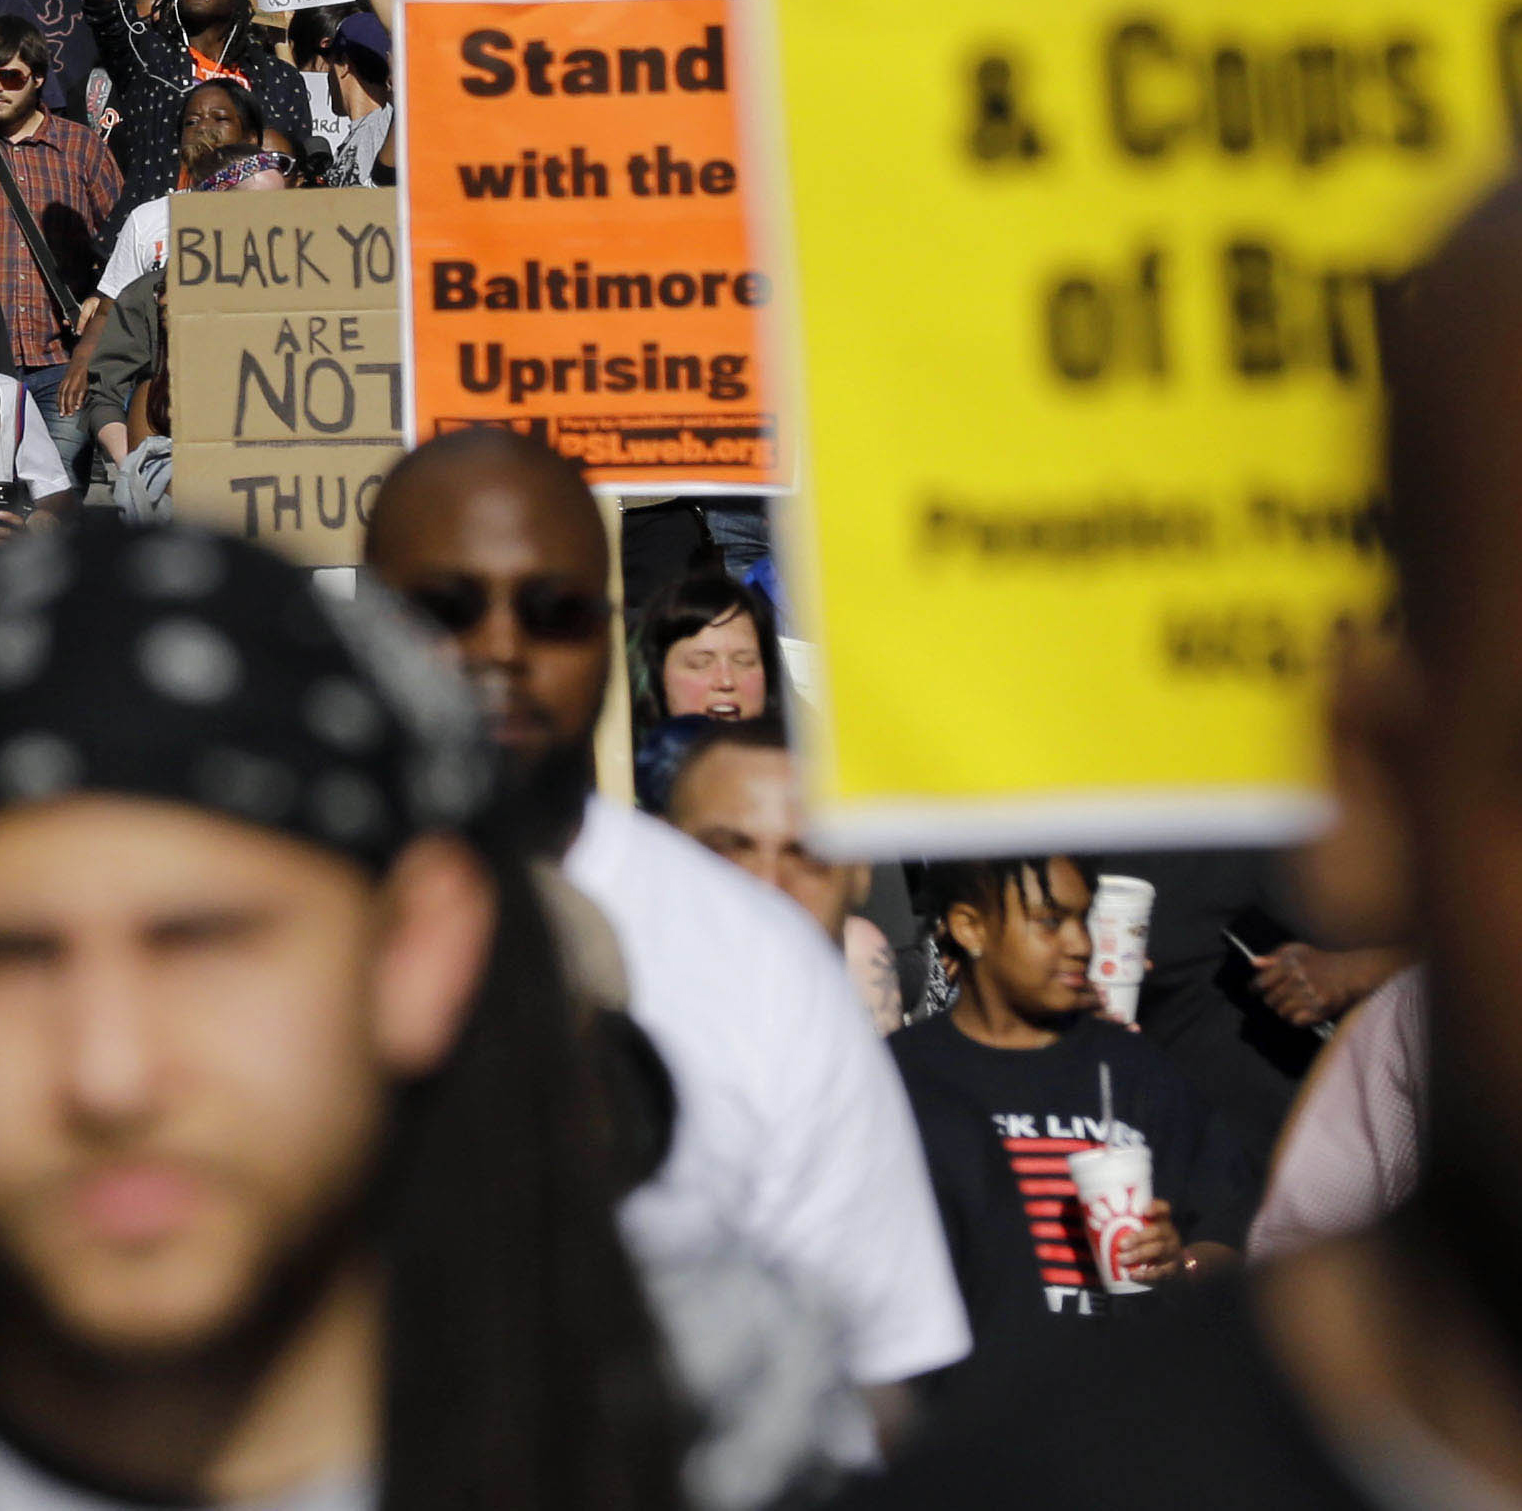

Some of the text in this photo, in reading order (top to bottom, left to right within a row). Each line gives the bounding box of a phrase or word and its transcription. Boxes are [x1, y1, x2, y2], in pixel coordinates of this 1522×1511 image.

[459, 24, 729, 99] Stand
[968, 18, 1445, 168] & Cops
[458, 144, 738, 200] with the
[177, 223, 331, 289] BLACK
[430, 258, 775, 313] Baltimore
[274, 316, 363, 354] ARE
[232, 349, 406, 437] NOT
[457, 340, 751, 404] Uprising
